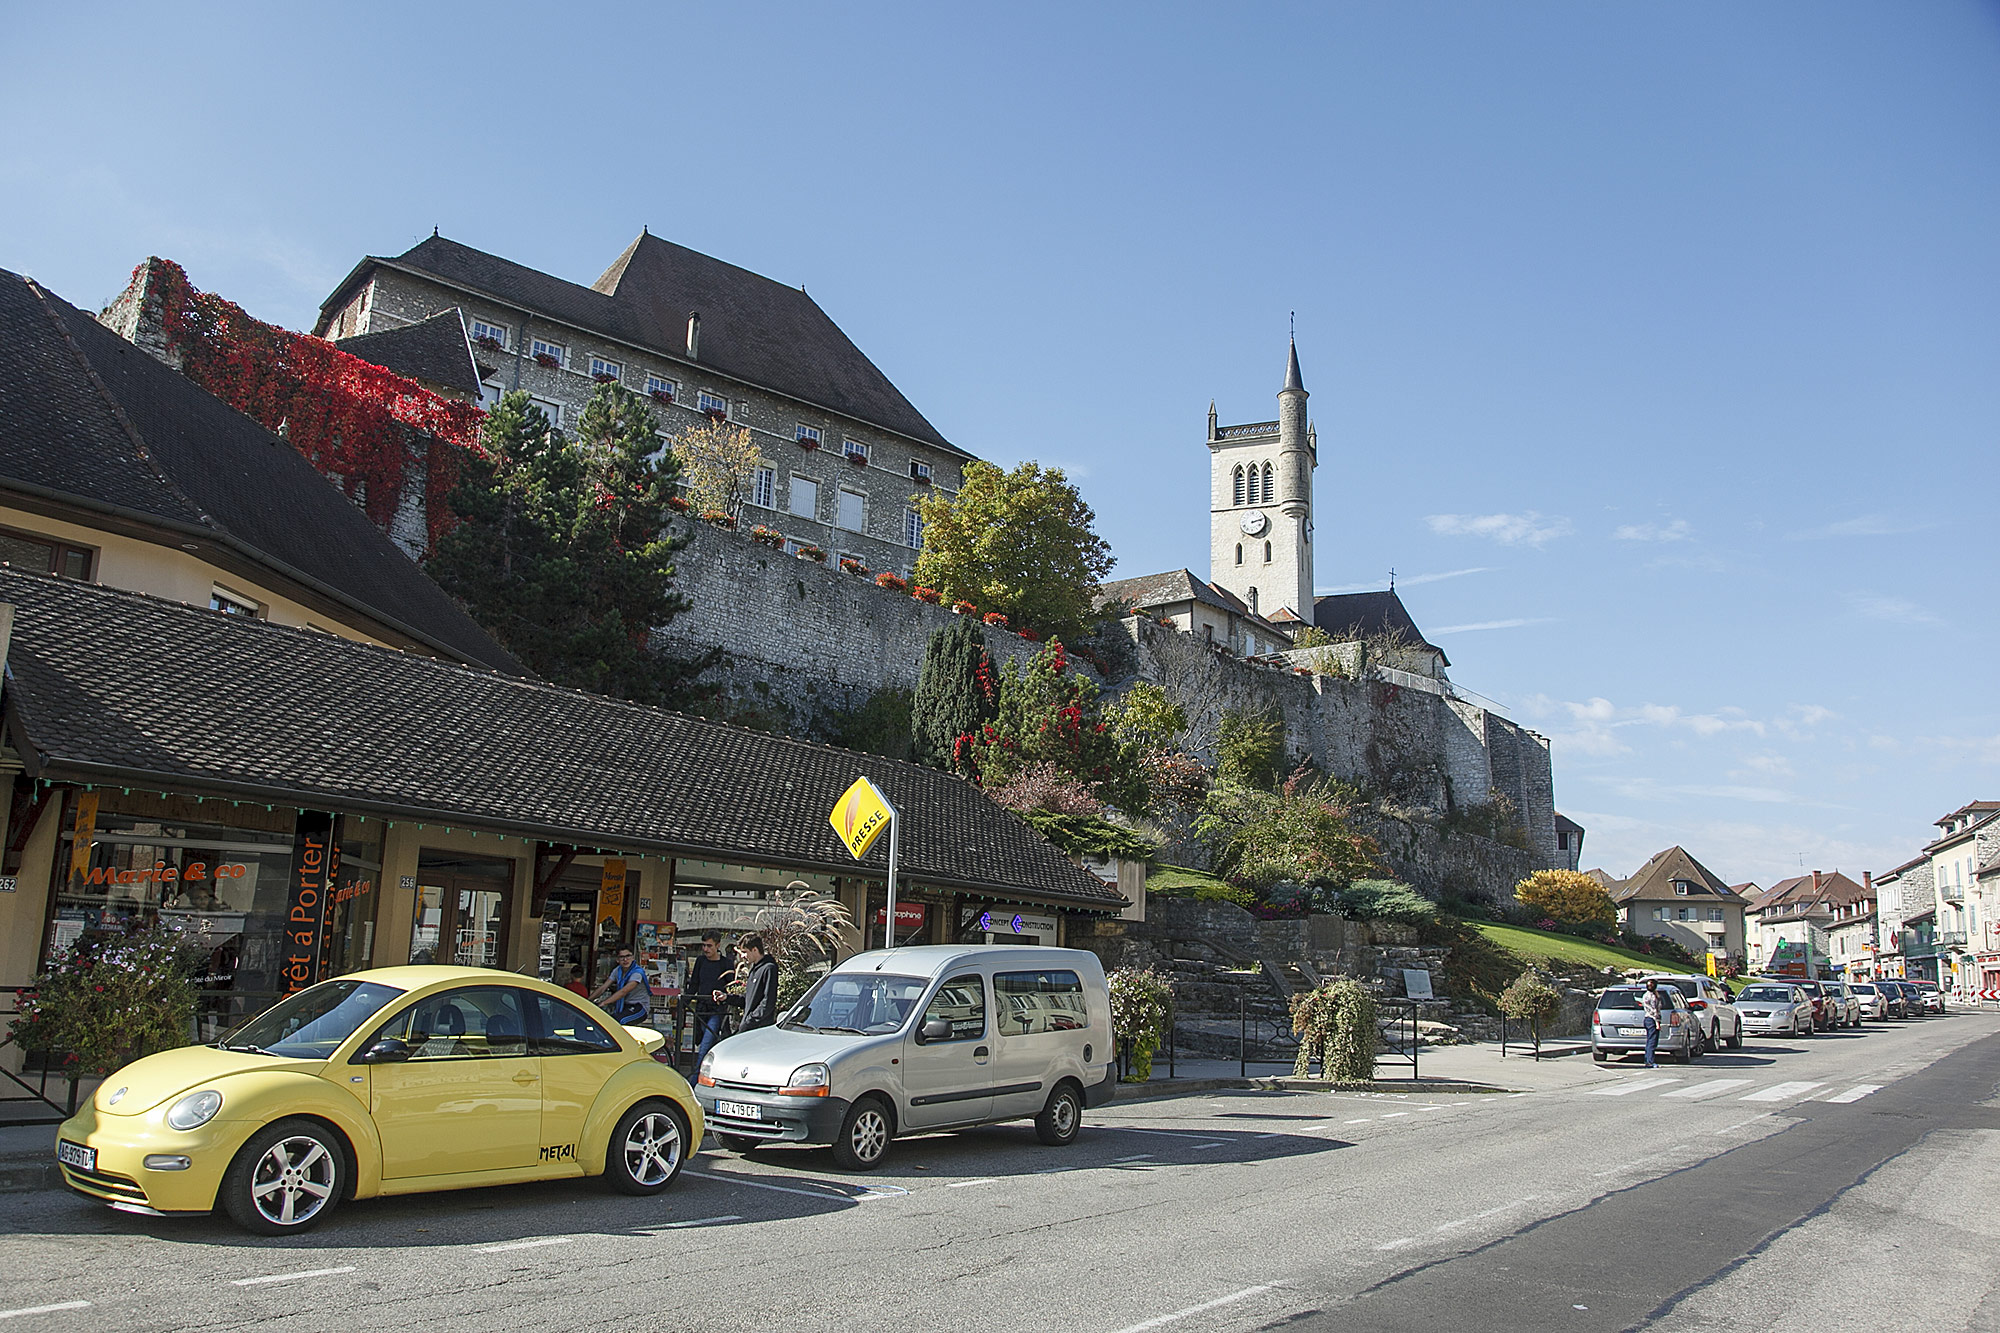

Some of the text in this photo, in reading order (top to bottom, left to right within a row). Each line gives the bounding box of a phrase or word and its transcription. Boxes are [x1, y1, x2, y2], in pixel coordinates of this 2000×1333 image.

[851, 810, 884, 852] PRESSE
[0, 878, 16, 890] 262
[83, 861, 246, 885] Marie & co
[290, 837, 323, 923] Porter
[402, 878, 414, 888] 256
[335, 880, 354, 902] arie
